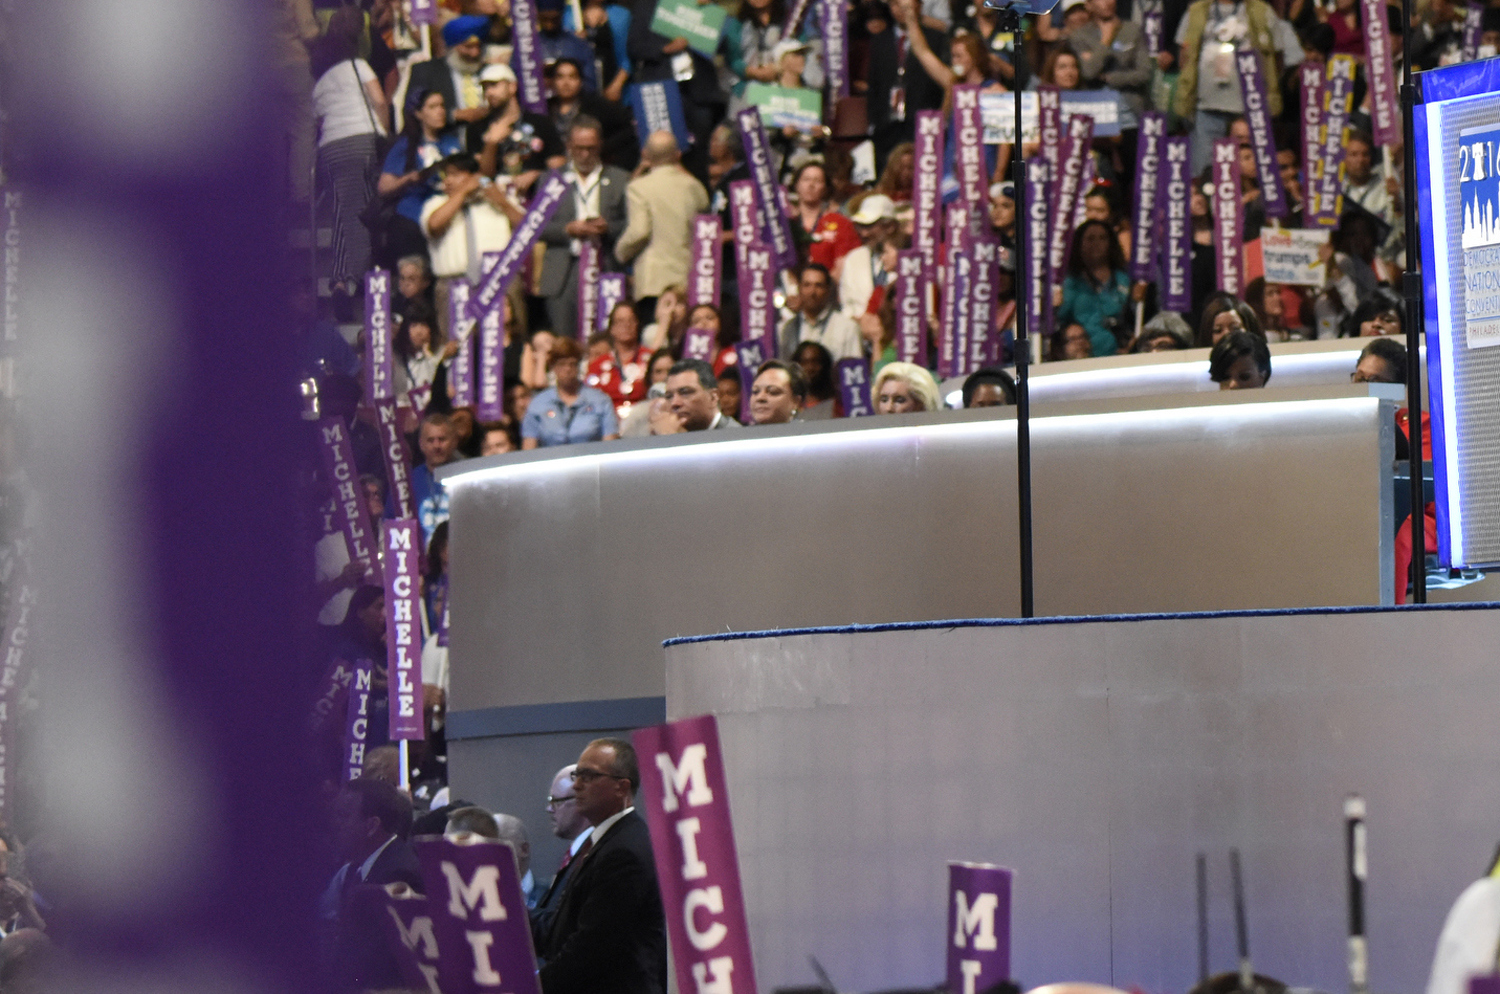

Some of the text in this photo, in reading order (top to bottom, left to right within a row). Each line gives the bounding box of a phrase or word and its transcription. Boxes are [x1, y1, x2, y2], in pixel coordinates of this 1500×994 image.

[740, 111, 788, 255] MICHELLE
[1051, 118, 1090, 268] MICHELLE
[1137, 118, 1163, 264] MICHELLE
[1239, 54, 1279, 202] MICHELLE
[1321, 58, 1352, 211] MICHELLE
[478, 175, 566, 306] MICHELLE
[1166, 142, 1187, 296] MICHELLE
[1216, 144, 1239, 295] MICHELLE
[389, 527, 414, 717] MICHELLE
